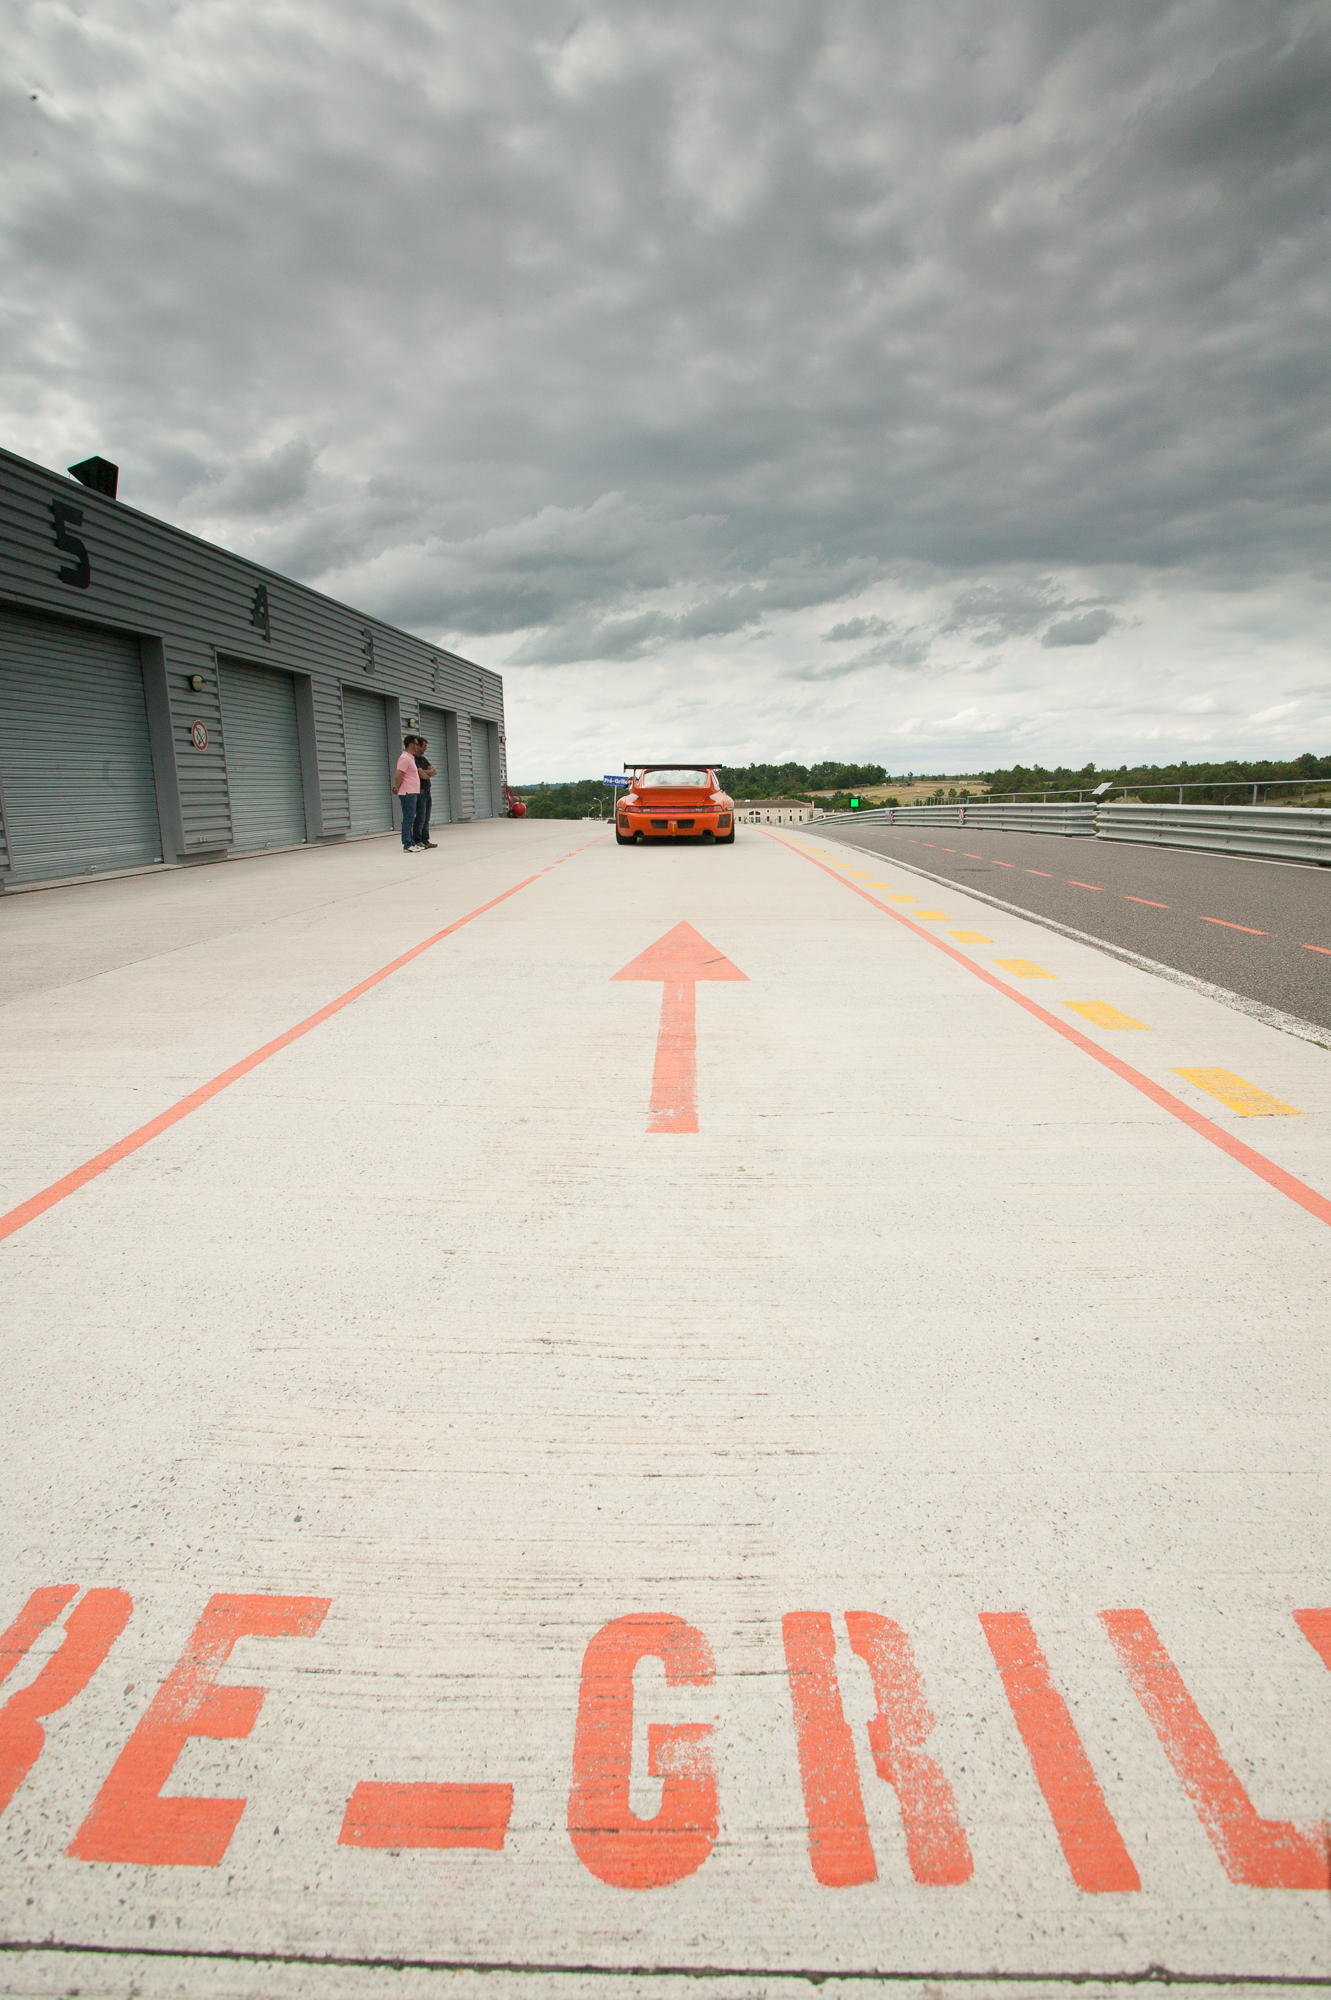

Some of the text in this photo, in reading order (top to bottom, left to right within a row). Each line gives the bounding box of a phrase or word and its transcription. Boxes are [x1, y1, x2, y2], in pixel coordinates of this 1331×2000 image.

[53, 498, 91, 589] 5
[252, 584, 271, 643] 4
[363, 628, 375, 675] 3
[433, 655, 442, 694] 2
